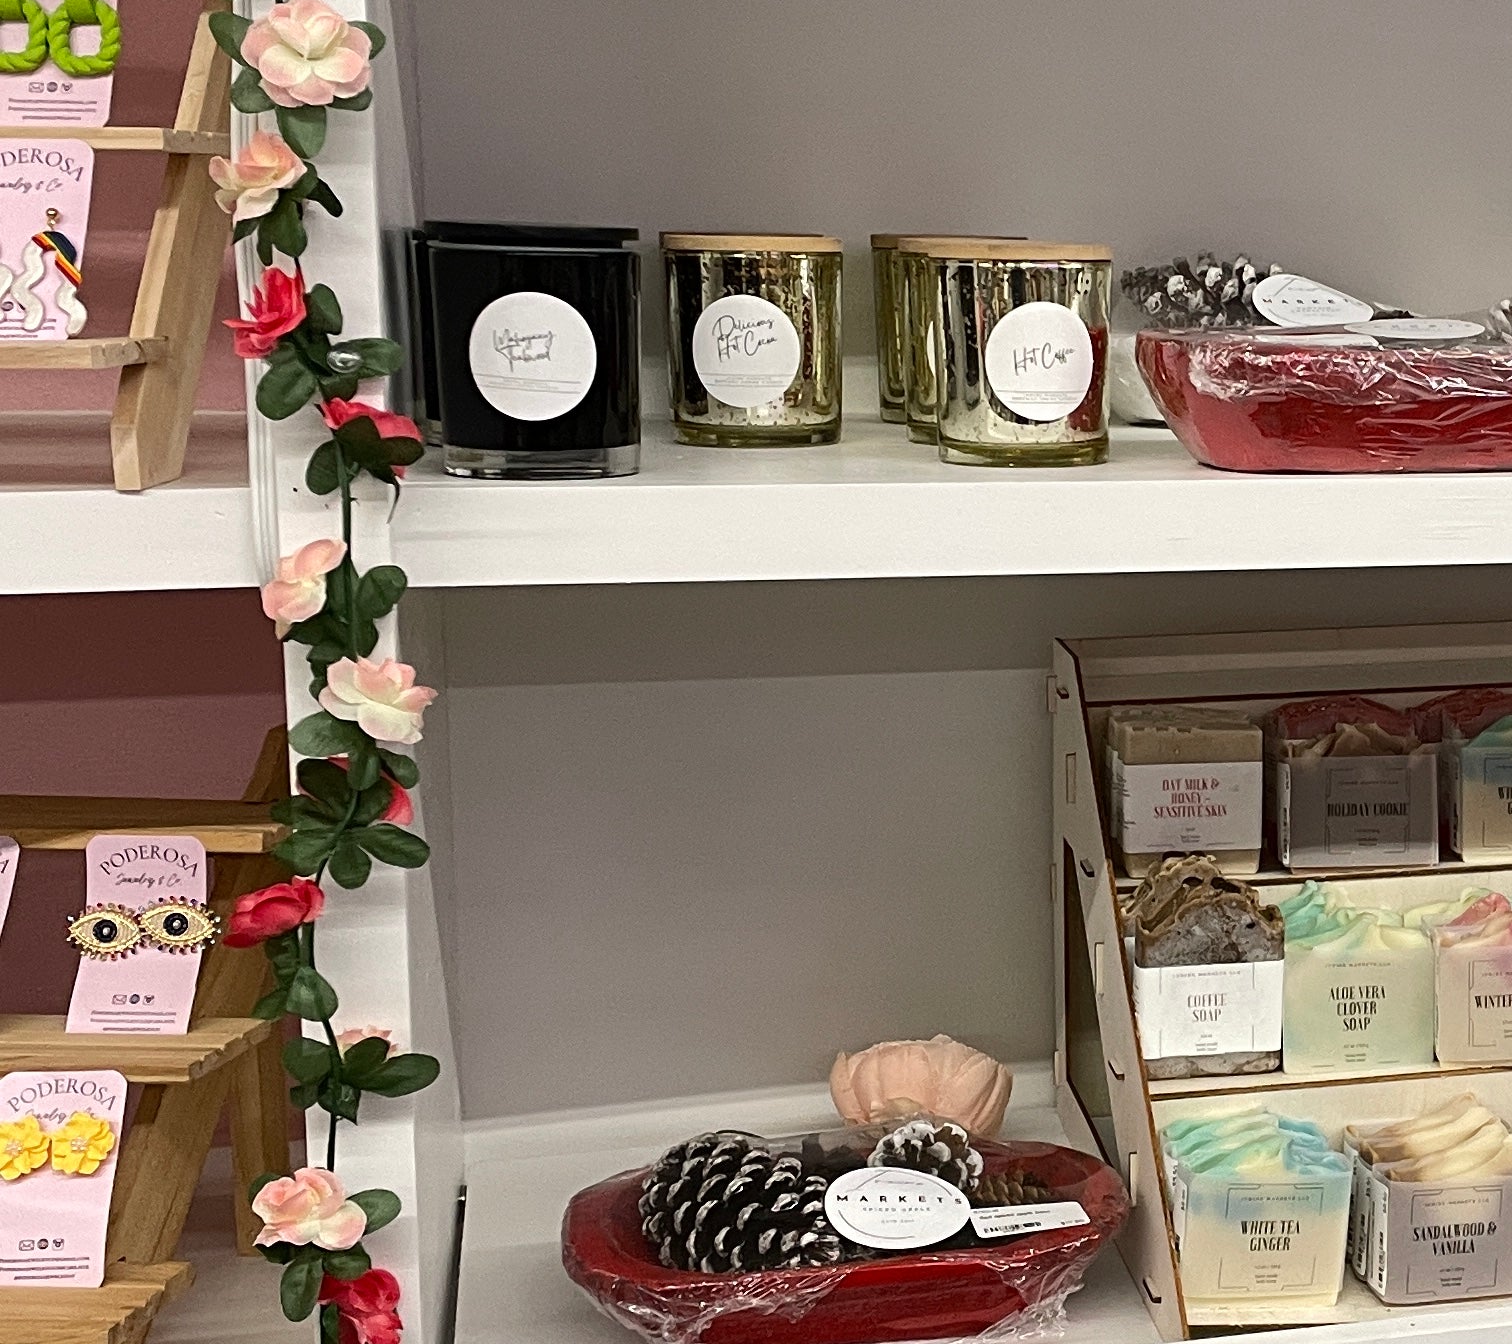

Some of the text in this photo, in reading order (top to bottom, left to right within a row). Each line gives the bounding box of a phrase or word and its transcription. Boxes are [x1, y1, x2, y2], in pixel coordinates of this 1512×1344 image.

[1162, 777, 1220, 791] OAT MILK &
[1171, 792, 1201, 804] HONEY
[1153, 803, 1227, 819] SENSITIVE SKIN
[1327, 801, 1409, 817] HOLIDAY COOKIE
[99, 845, 199, 878] PODEROSA
[1187, 993, 1228, 1008] COFFEE
[1328, 985, 1386, 1002] ALOE VERA
[1192, 1008, 1222, 1023] SOAP
[1336, 1001, 1377, 1017] CLOVER
[1342, 1017, 1371, 1032] SOAP
[7, 1078, 117, 1112] PODEROSA
[836, 1194, 962, 1205] MARKETS
[1240, 1219, 1301, 1235] WHITE TEA
[1412, 1221, 1498, 1242] SANDALWOOD &
[1249, 1236, 1291, 1251] GINGER
[1432, 1239, 1476, 1256] VANILLA
